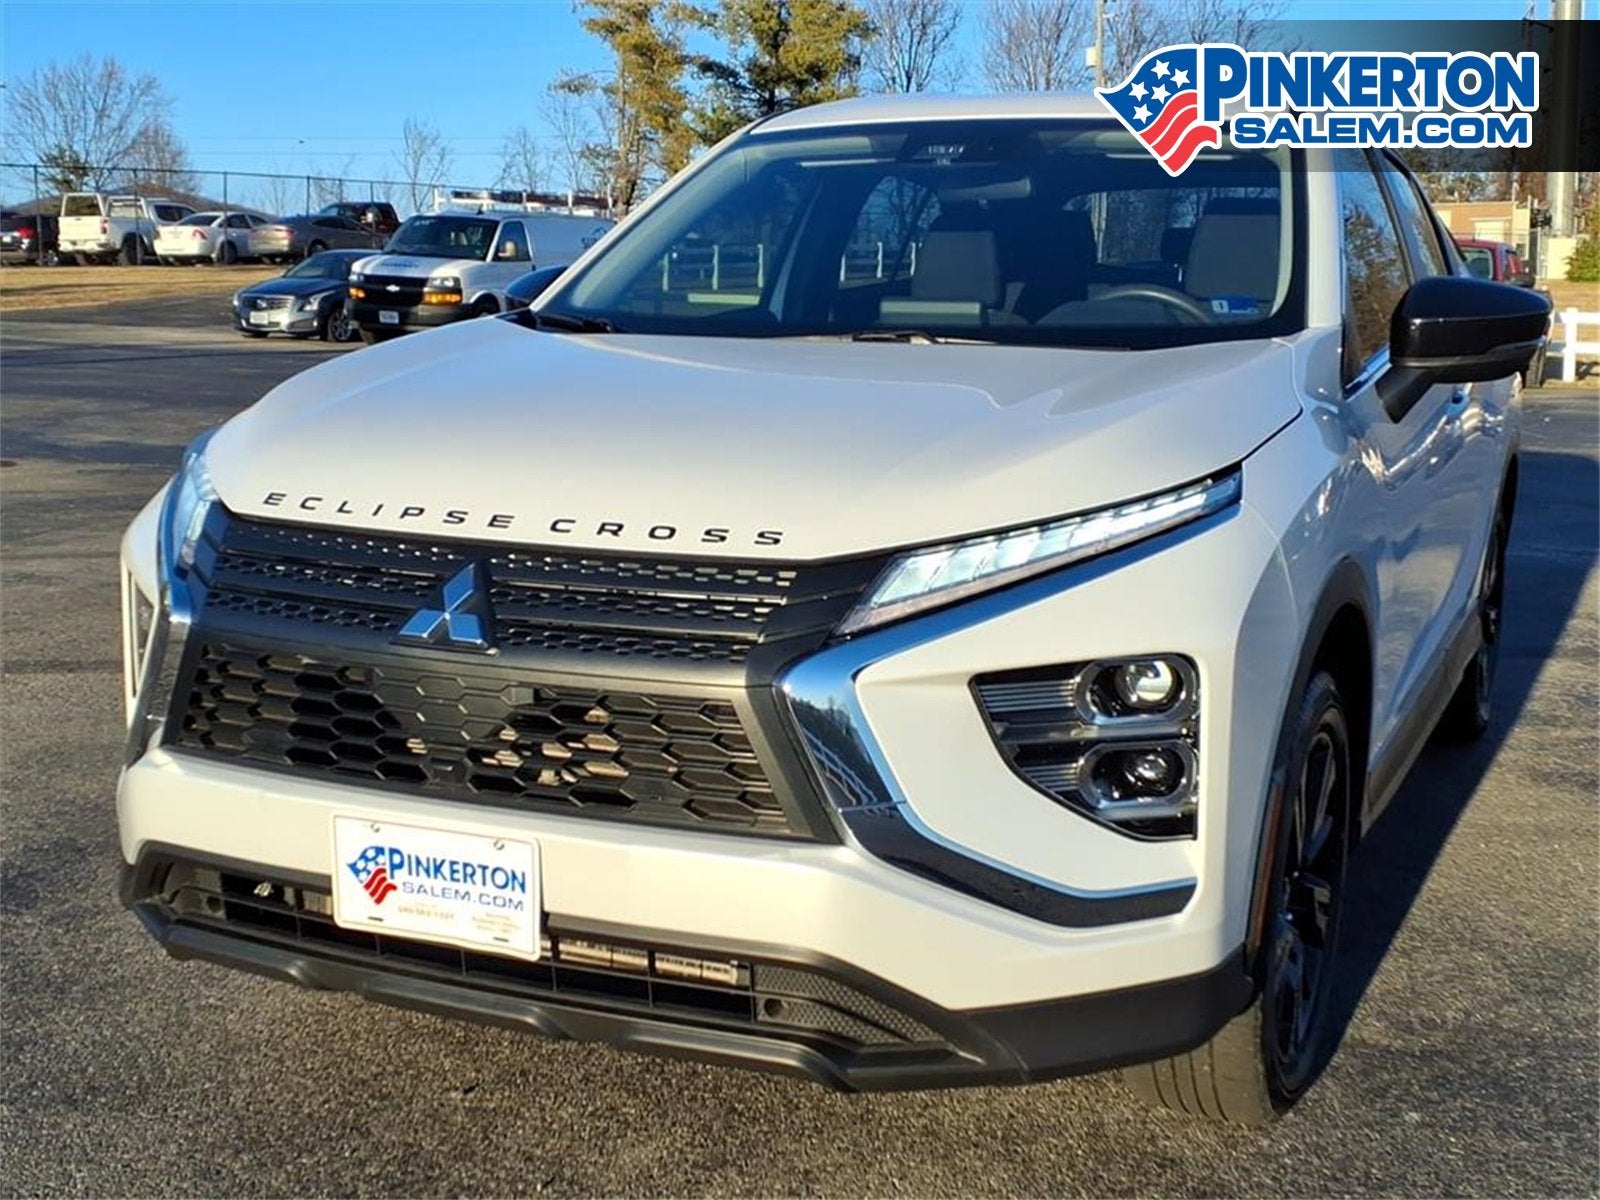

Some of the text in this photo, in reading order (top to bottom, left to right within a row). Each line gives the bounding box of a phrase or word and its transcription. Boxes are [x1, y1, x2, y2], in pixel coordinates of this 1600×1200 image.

[263, 492, 784, 546] ECLIPSE CROSS
[388, 847, 526, 894] PINKERTON
[402, 881, 524, 911] SALEM.COM
